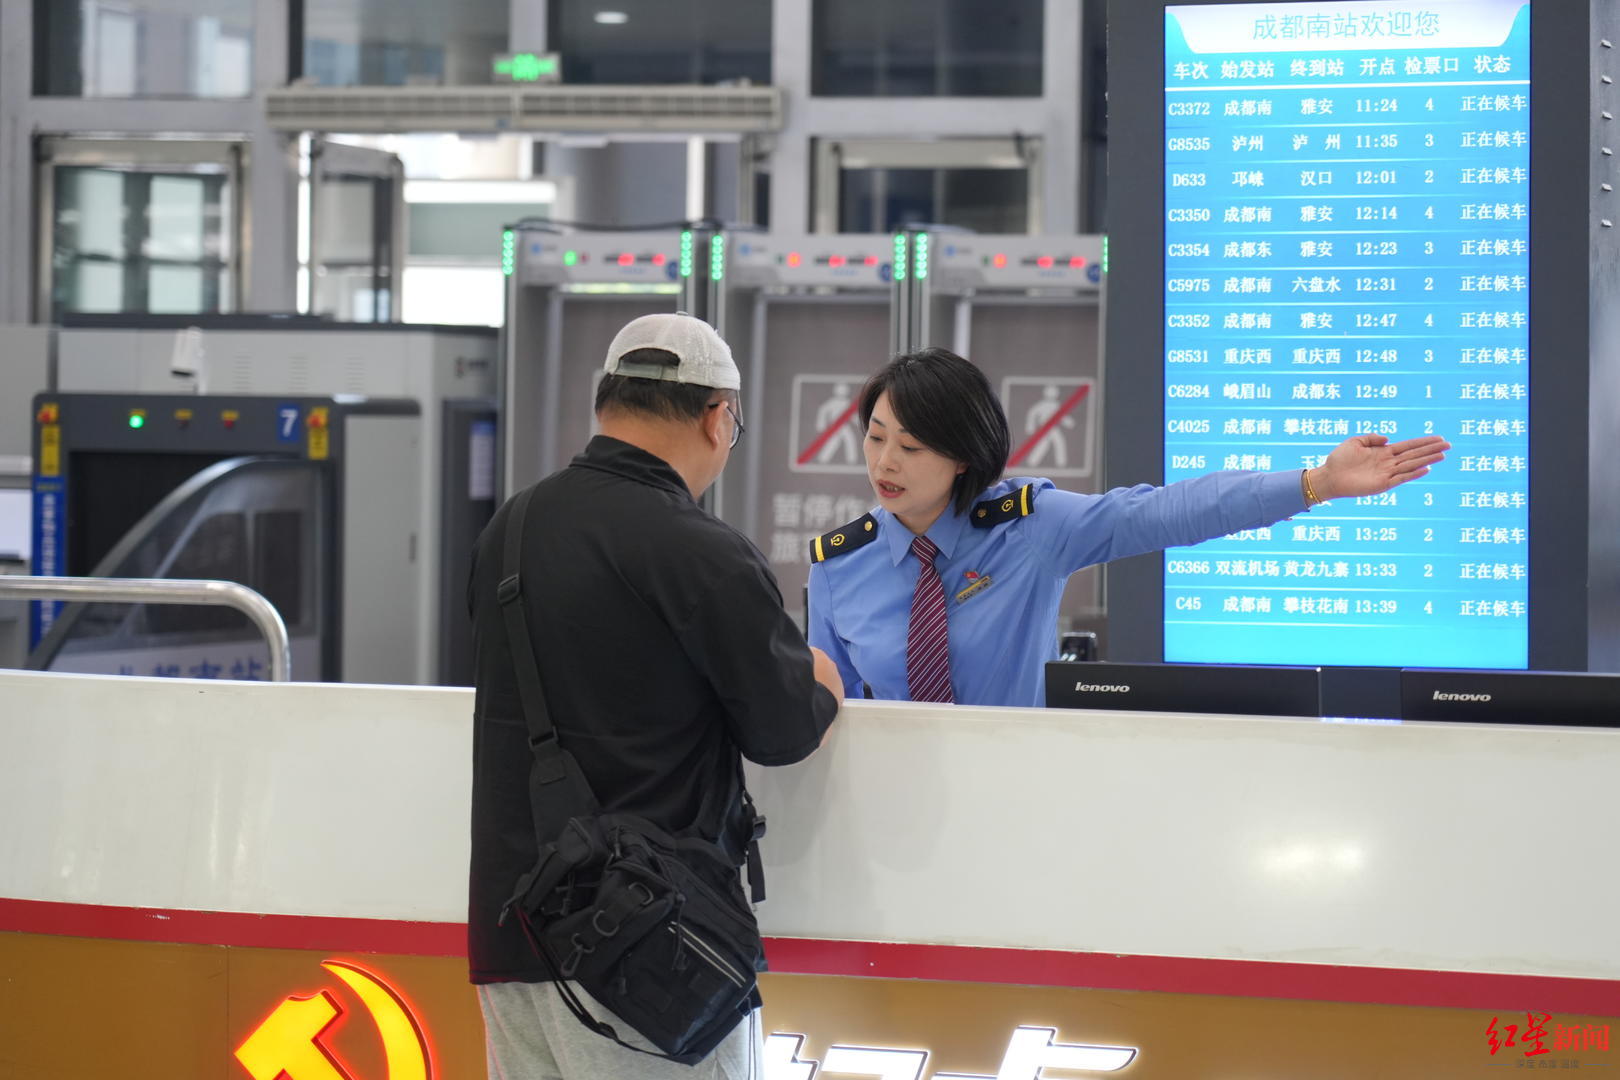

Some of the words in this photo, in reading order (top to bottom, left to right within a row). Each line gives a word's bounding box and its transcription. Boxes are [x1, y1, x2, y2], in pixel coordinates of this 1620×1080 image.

[1253, 10, 1440, 40] 成都南站欢迎您
[1173, 61, 1209, 80] 车次
[1221, 60, 1275, 79] 始发站
[1290, 58, 1345, 77] 终到站
[1359, 56, 1396, 76] 开点
[1404, 55, 1459, 75] 检票口
[1473, 54, 1511, 74] 状态
[1168, 101, 1211, 116] C3372
[1224, 99, 1272, 116] 成都南
[1300, 98, 1333, 115] 雅安
[1356, 98, 1398, 113] 11:24
[1425, 97, 1434, 111] 4
[1461, 94, 1527, 112] 正在候车
[1168, 137, 1211, 151] G8535
[1231, 135, 1264, 152] 泸州
[1356, 133, 1399, 148] 11:35
[1424, 133, 1435, 147] 3
[1461, 130, 1527, 148] 正在候车
[1172, 173, 1207, 187] D633
[1231, 170, 1265, 187] 邛崃
[1300, 170, 1332, 187] 汉口
[1356, 170, 1396, 185] 12:01
[1424, 169, 1434, 184] 2
[1460, 167, 1527, 184] 正在候车
[1168, 208, 1211, 222] C3350
[1223, 206, 1272, 223] 成都南
[1300, 205, 1333, 222] 雅安
[1356, 206, 1398, 220] 12:14
[1424, 206, 1434, 220] 4
[1460, 203, 1527, 220] 正在候车
[1168, 243, 1210, 257] C3354
[1223, 241, 1272, 258] 成都东
[1300, 240, 1333, 258] 雅安
[1356, 241, 1398, 256] 12:23
[1424, 241, 1434, 255] 3
[1461, 238, 1527, 256] 正在候车
[1167, 278, 1210, 292] C5975
[1223, 276, 1272, 293] 成都南
[1292, 276, 1341, 293] 六盘水
[1356, 277, 1396, 292] 12:31
[1424, 277, 1434, 291] 2
[1460, 274, 1527, 292] 正在候车
[1167, 314, 1211, 328] C3352
[1223, 312, 1272, 329] 成都南
[1300, 312, 1333, 329] 雅安
[1356, 313, 1398, 328] 12:47
[1424, 313, 1434, 327] 4
[1460, 311, 1527, 329] 正在候车
[1167, 349, 1209, 363] G8531
[1224, 347, 1272, 365] 重庆西
[1292, 347, 1341, 365] 重庆西
[1356, 349, 1398, 363] 12:48
[1424, 349, 1434, 363] 3
[1460, 347, 1526, 365] 正在候车
[1167, 384, 1210, 398] C6284
[1223, 383, 1271, 400] 峨眉山
[1292, 383, 1341, 400] 成都东
[1356, 384, 1398, 399] 12:49
[1425, 384, 1432, 399] 1
[1460, 383, 1527, 400] 正在候车
[280, 409, 298, 437] 7
[1167, 419, 1210, 433] C4025
[1223, 418, 1272, 435] 成都南
[1283, 418, 1350, 436] 攀枝花南
[1356, 420, 1398, 435] 12:53
[1423, 420, 1434, 434] 2
[1460, 419, 1526, 436] 正在候车
[1172, 455, 1206, 469] D245
[1223, 454, 1271, 471] 成都南
[1459, 455, 1526, 473] 正在候车
[1423, 492, 1433, 506] 3
[1459, 491, 1526, 509] 正在候车
[1292, 525, 1341, 542] 重庆西
[1355, 527, 1397, 542] 13:25
[1423, 527, 1434, 542] 2
[1460, 527, 1526, 545] 正在候车
[1167, 560, 1210, 574] C6366
[1215, 559, 1280, 577] 双流机场
[1284, 560, 1349, 578] 黄龙九寨
[1356, 563, 1397, 577] 13:33
[1423, 563, 1434, 578] 2
[1459, 563, 1526, 580] 正在候车
[1175, 596, 1202, 611] C45
[1223, 596, 1271, 613] 成都南
[1283, 596, 1349, 615] 攀枝花南
[1355, 599, 1398, 614] 13:39
[1423, 601, 1433, 615] 4
[1459, 599, 1526, 617] 正在候车
[1075, 681, 1130, 694] lenovo
[1432, 690, 1491, 703] lenovo
